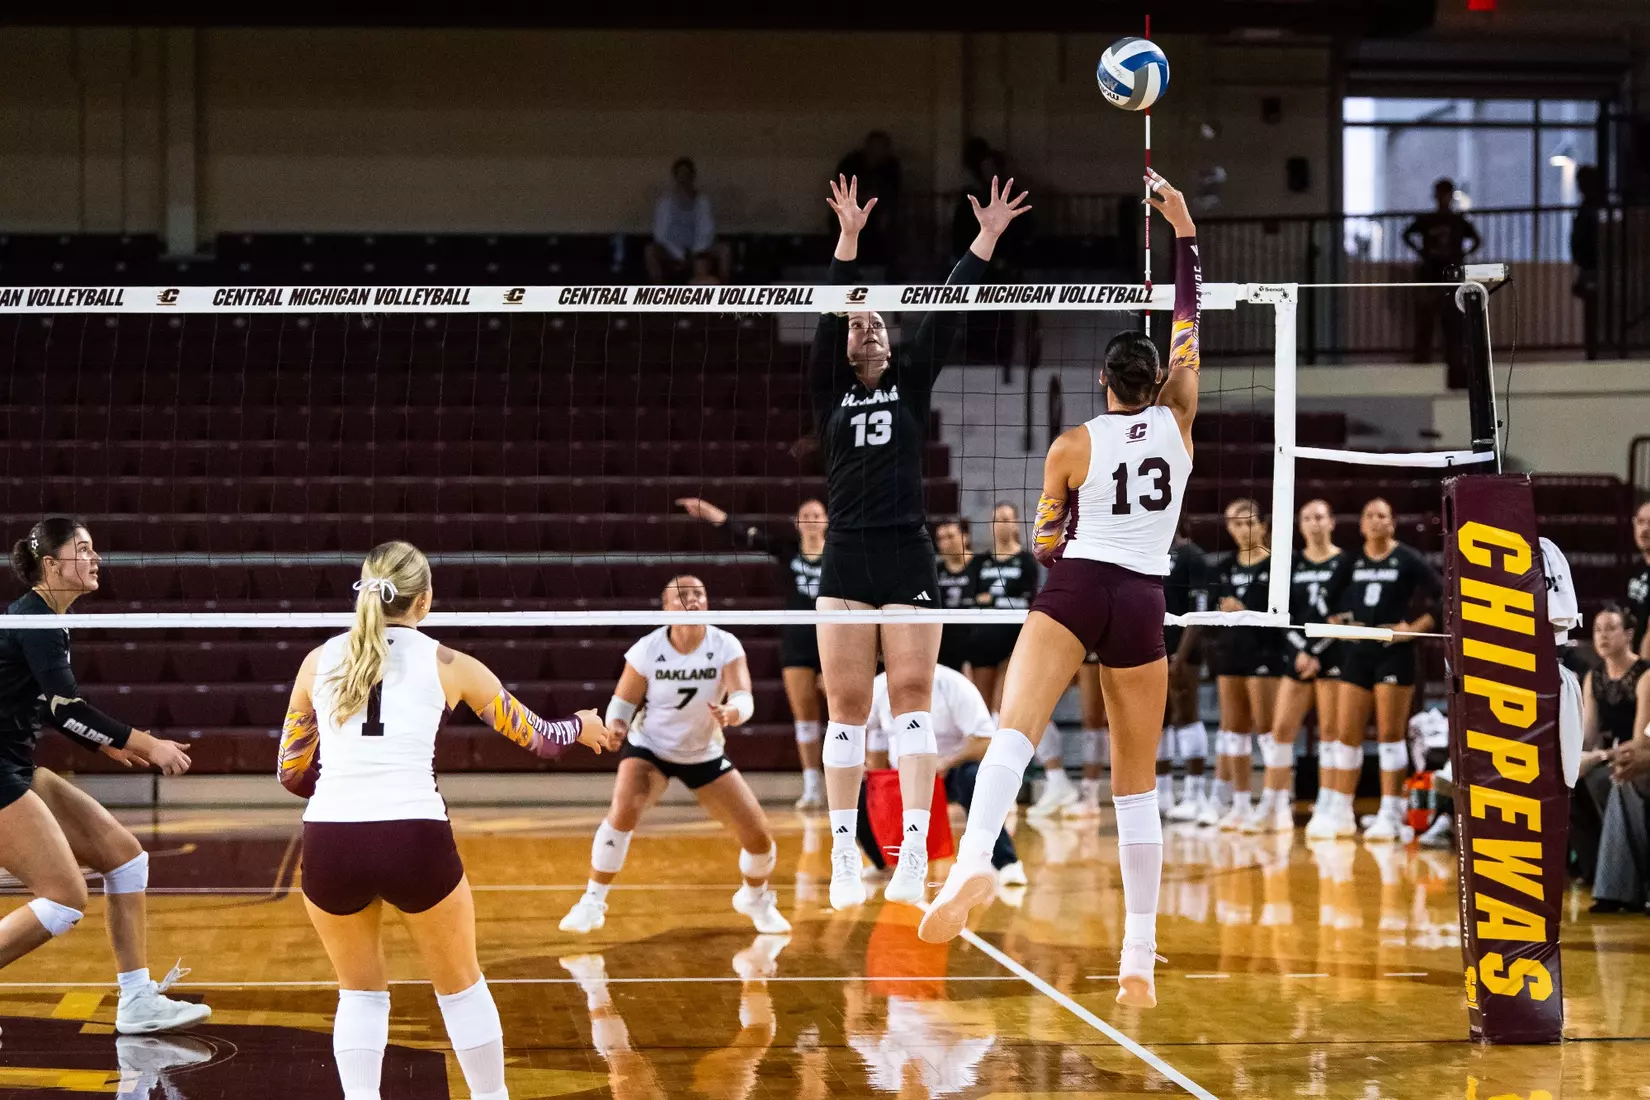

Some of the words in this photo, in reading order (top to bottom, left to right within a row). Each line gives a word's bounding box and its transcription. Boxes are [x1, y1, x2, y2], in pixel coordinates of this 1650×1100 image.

[0, 288, 24, 306] AN
[26, 288, 125, 307] VOLLEYBALL
[212, 288, 284, 306] CENTRAL
[288, 288, 371, 306] MICHIGAN
[373, 287, 471, 305] VOLLEYBALL
[558, 287, 629, 305] CENTRAL
[632, 287, 713, 305] MICHIGAN
[717, 287, 814, 305] VOLLEYBALL
[900, 286, 970, 304] CENTRAL
[973, 286, 1053, 304] MICHIGAN
[1057, 285, 1154, 304] VOLLEYBALL
[850, 410, 893, 447] 13
[1111, 456, 1173, 515] 13
[655, 667, 718, 681] OAKLAND
[361, 678, 385, 736] 1
[676, 686, 699, 711] 7
[62, 717, 114, 746] GOLDEN
[1457, 520, 1554, 1002] CHIPPEWAS
[1457, 813, 1465, 873] sports
[1460, 875, 1470, 949] imports
